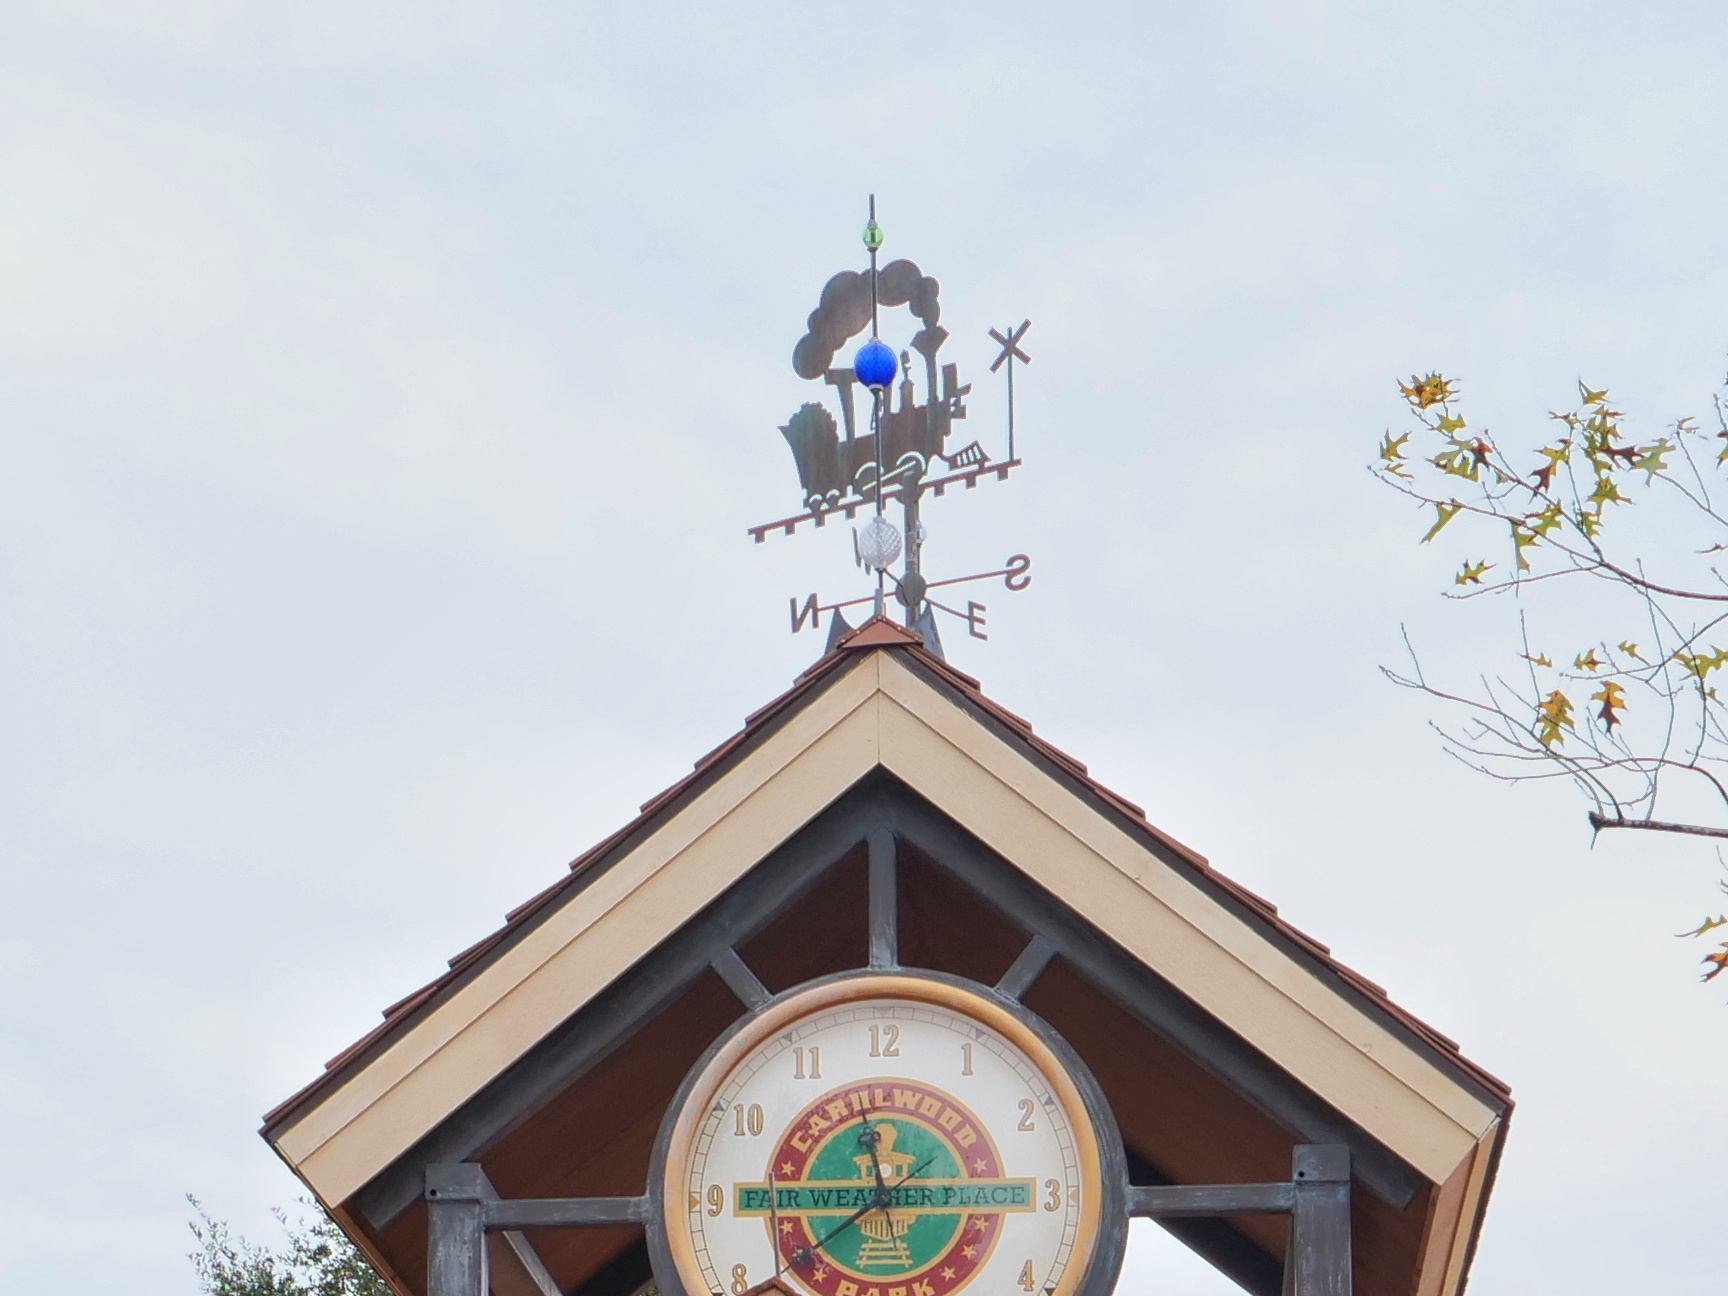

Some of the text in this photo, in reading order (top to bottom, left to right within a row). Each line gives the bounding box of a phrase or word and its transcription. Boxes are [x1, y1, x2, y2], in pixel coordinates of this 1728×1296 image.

[968, 601, 987, 641] E
[869, 1025, 899, 1057] 12
[793, 1047, 821, 1079] 11
[962, 1043, 973, 1075] 1
[734, 1104, 763, 1136] 10
[1018, 1099, 1035, 1131] 2
[707, 1185, 723, 1216] 9
[744, 1189, 801, 1208] FAIR
[943, 1186, 1025, 1205] PLACE
[1044, 1179, 1060, 1211] 3
[732, 1264, 747, 1296] 8
[1018, 1260, 1035, 1291] 4
